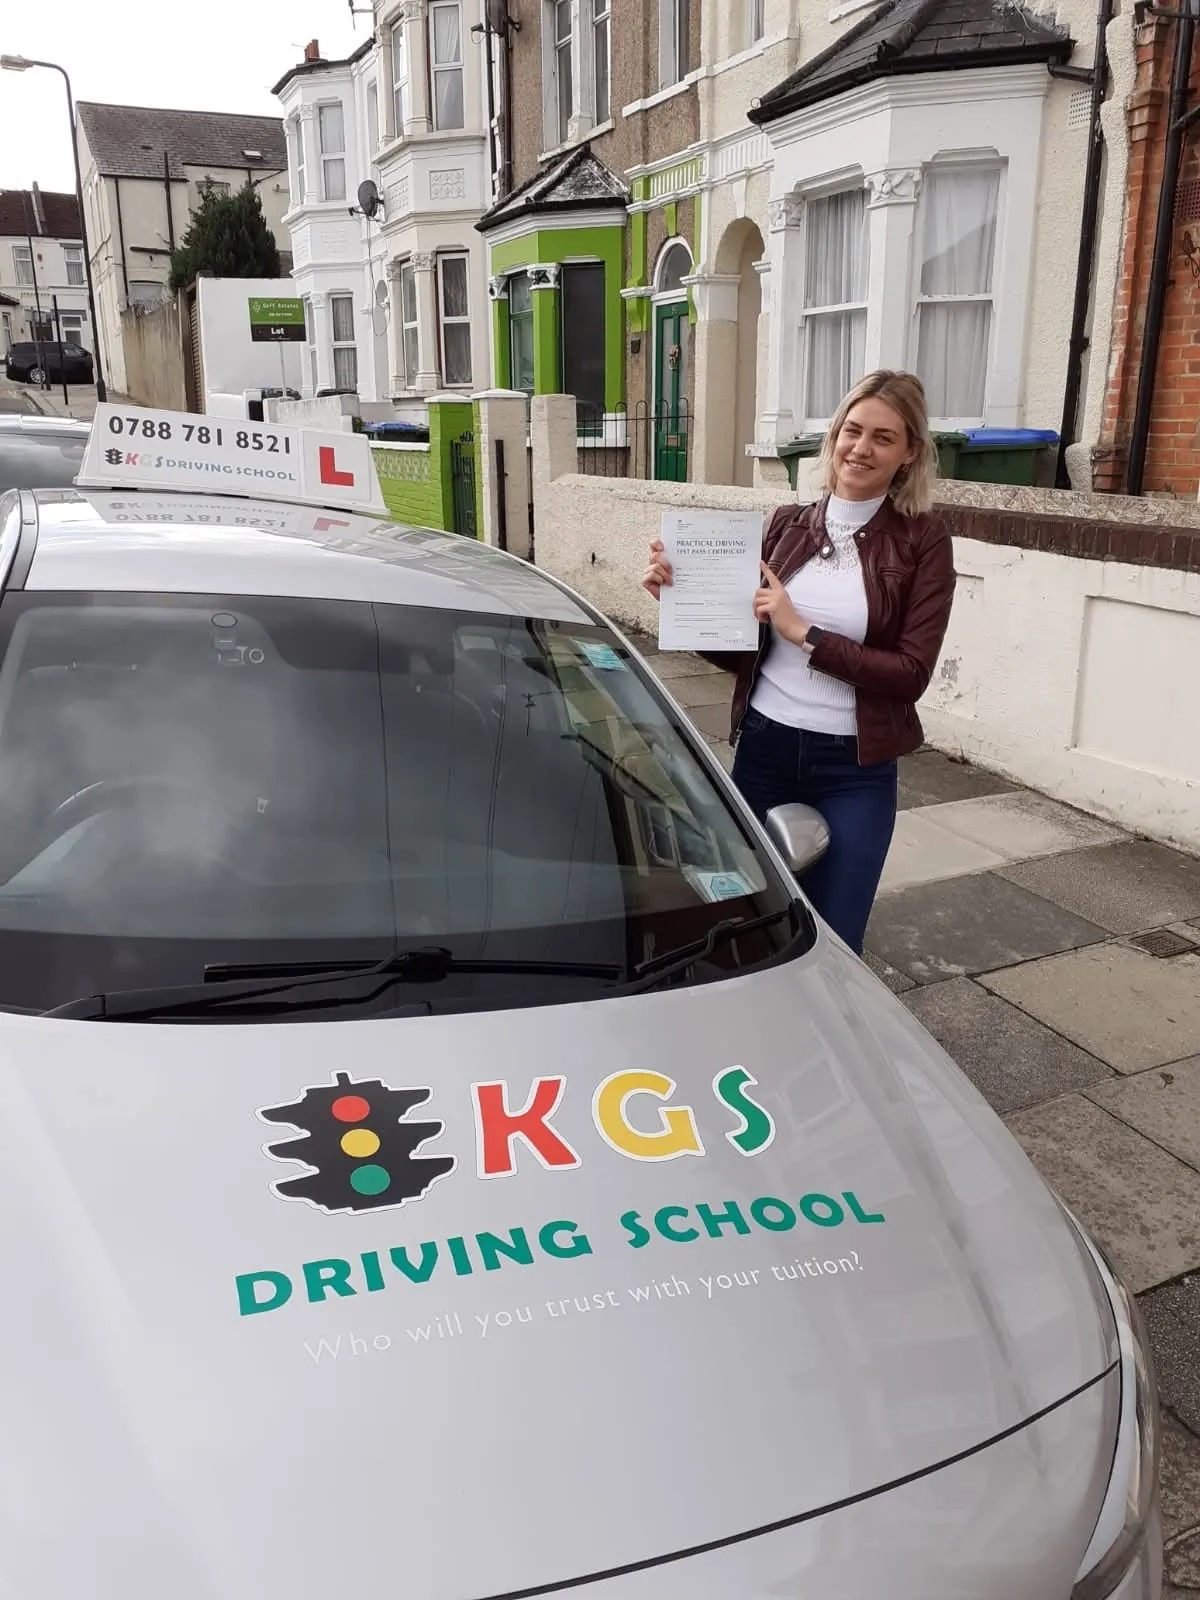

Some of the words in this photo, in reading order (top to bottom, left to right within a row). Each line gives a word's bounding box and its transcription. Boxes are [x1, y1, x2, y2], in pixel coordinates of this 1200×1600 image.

[271, 327, 284, 335] Let
[108, 415, 172, 440] 0788
[182, 424, 223, 446] 781
[235, 431, 290, 454] 8521
[166, 455, 233, 474] DRIVING
[236, 466, 297, 481] SCHOOL
[319, 446, 354, 487] L
[676, 539, 713, 547] PRACTICAL
[470, 1065, 776, 1180] KGS
[234, 1220, 593, 1316] DRIVING
[619, 1191, 885, 1249] SCHOOL
[303, 1332, 392, 1364] Who
[406, 1311, 464, 1344] will
[475, 1305, 533, 1338] you
[545, 1288, 621, 1319] trust
[627, 1274, 691, 1303] with
[699, 1267, 761, 1299] your
[771, 1250, 865, 1282] tuition?
